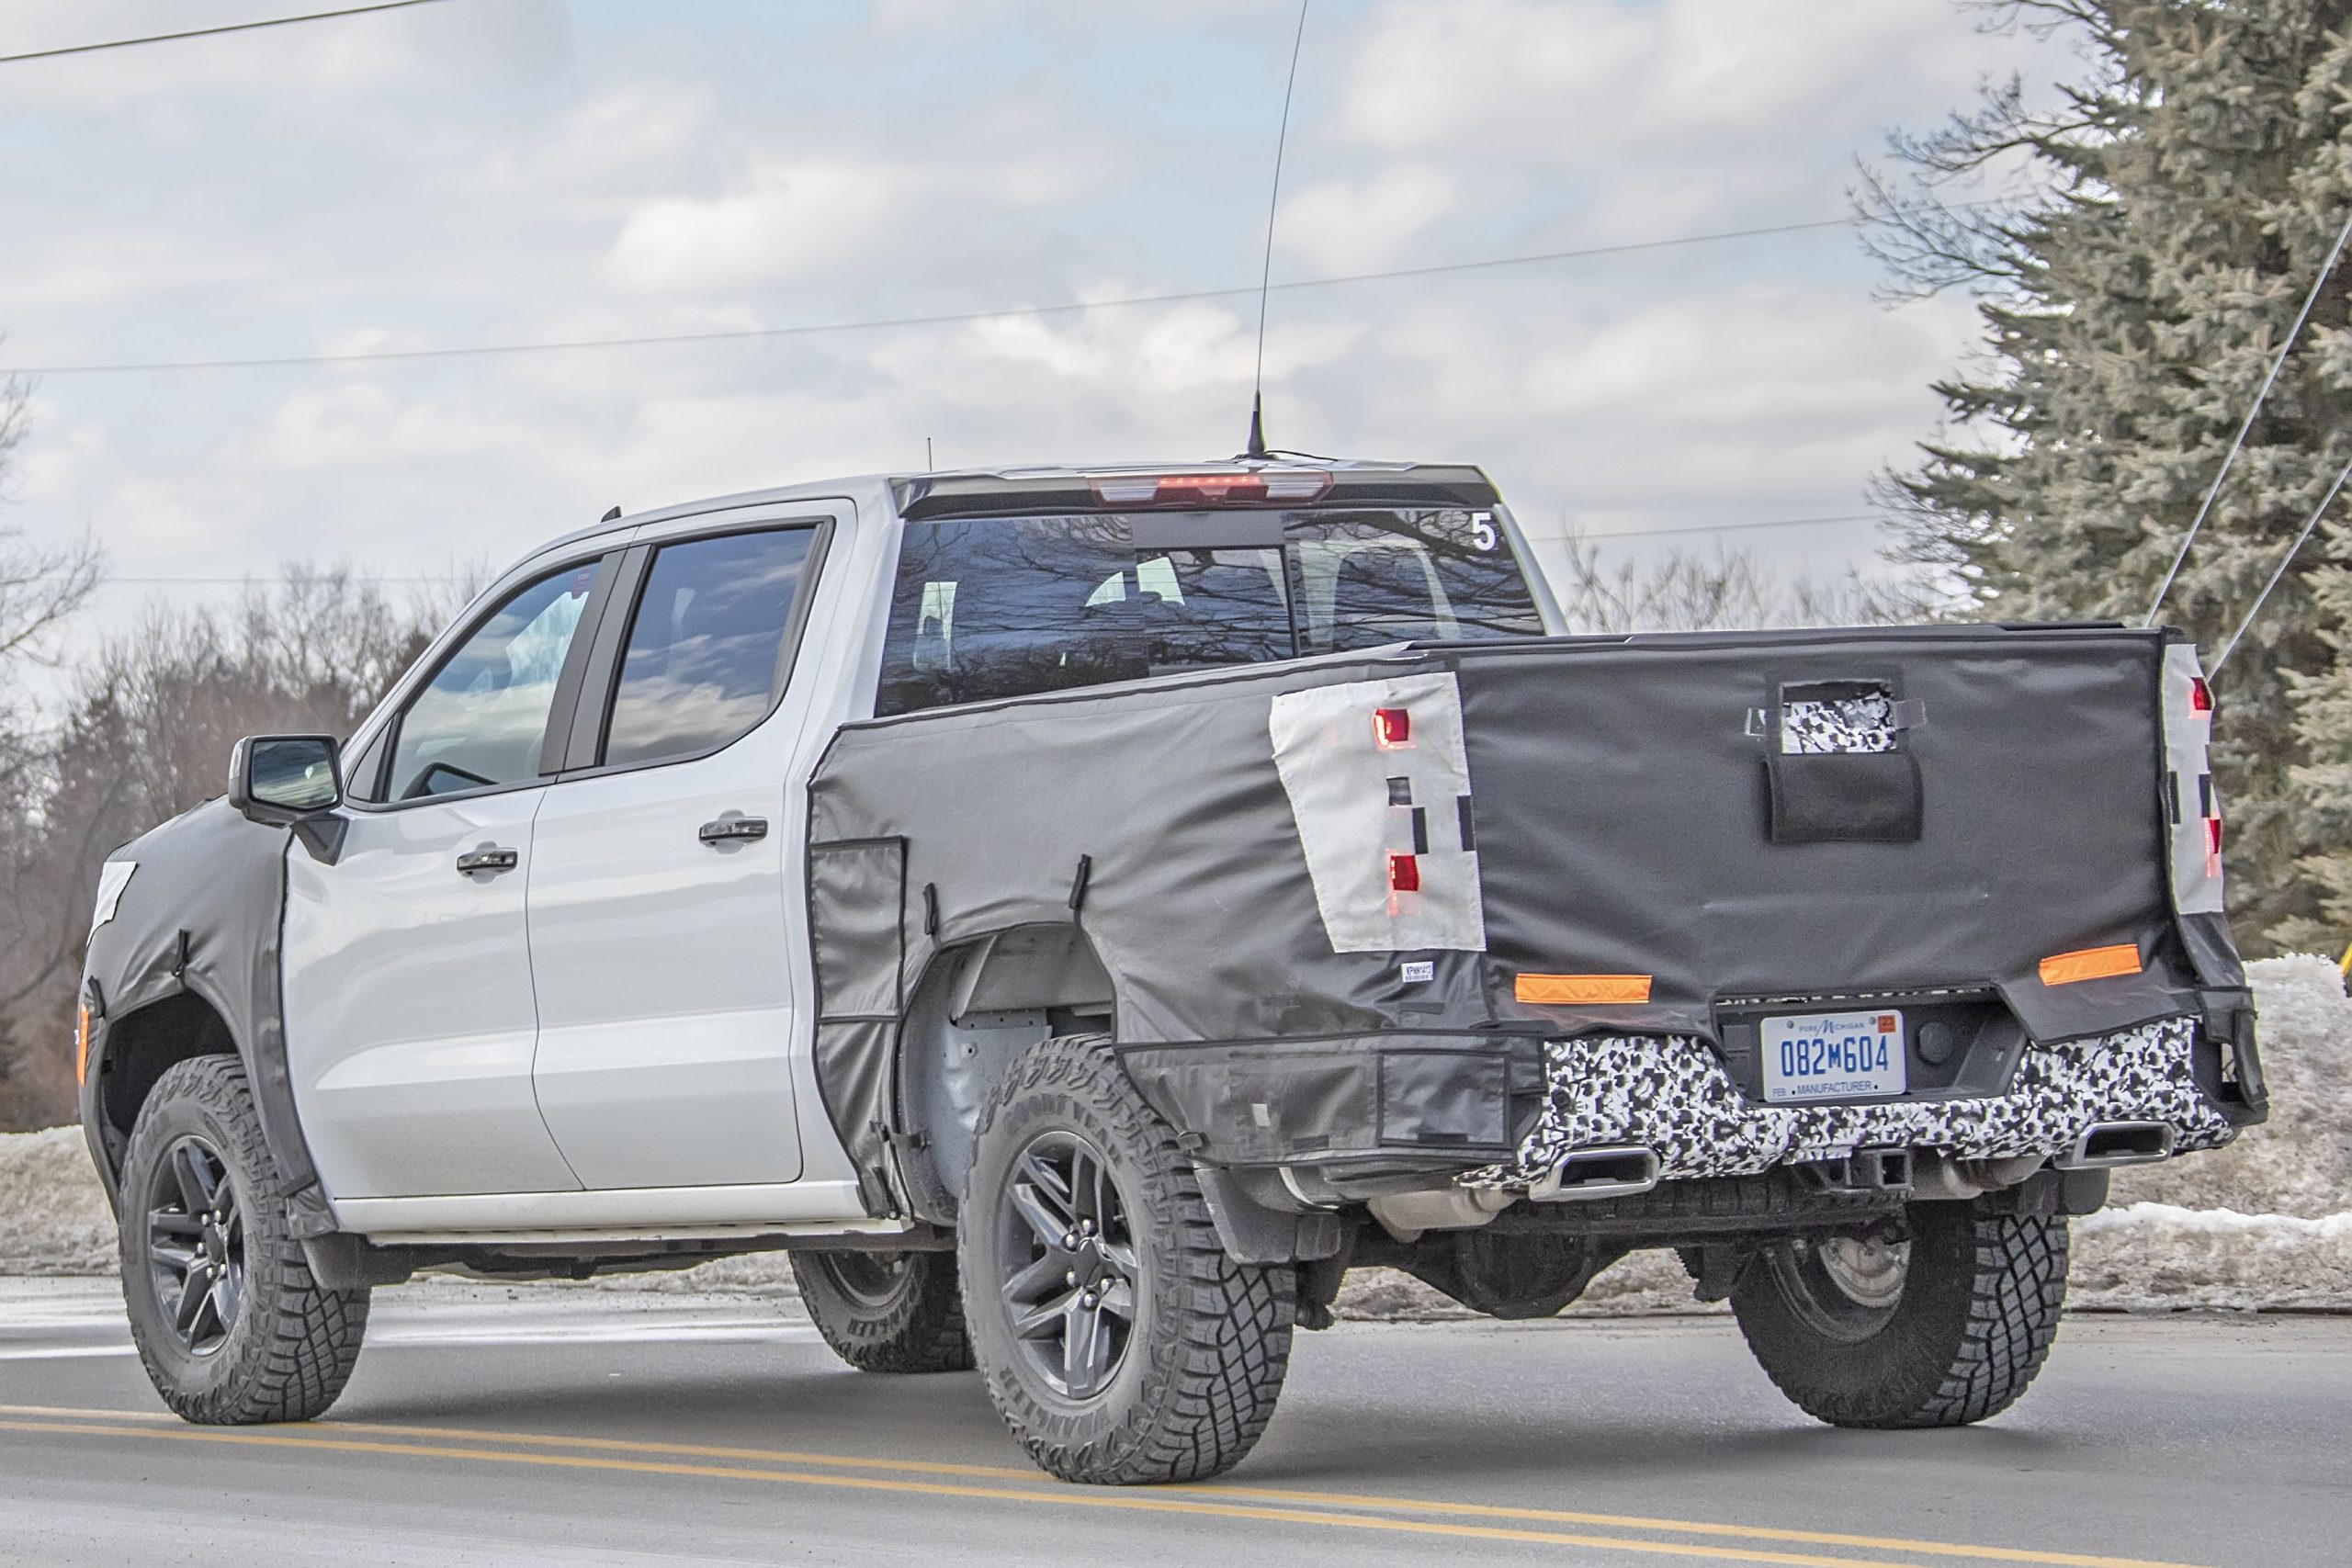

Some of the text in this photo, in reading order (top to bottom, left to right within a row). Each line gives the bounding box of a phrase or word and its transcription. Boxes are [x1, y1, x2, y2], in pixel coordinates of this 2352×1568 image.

[1472, 512, 1496, 551] 5
[1799, 1024, 1818, 1032] PURE
[1781, 1034, 1889, 1077] 082M604
[1772, 1080, 1872, 1097] FEB MANUFACTURER
